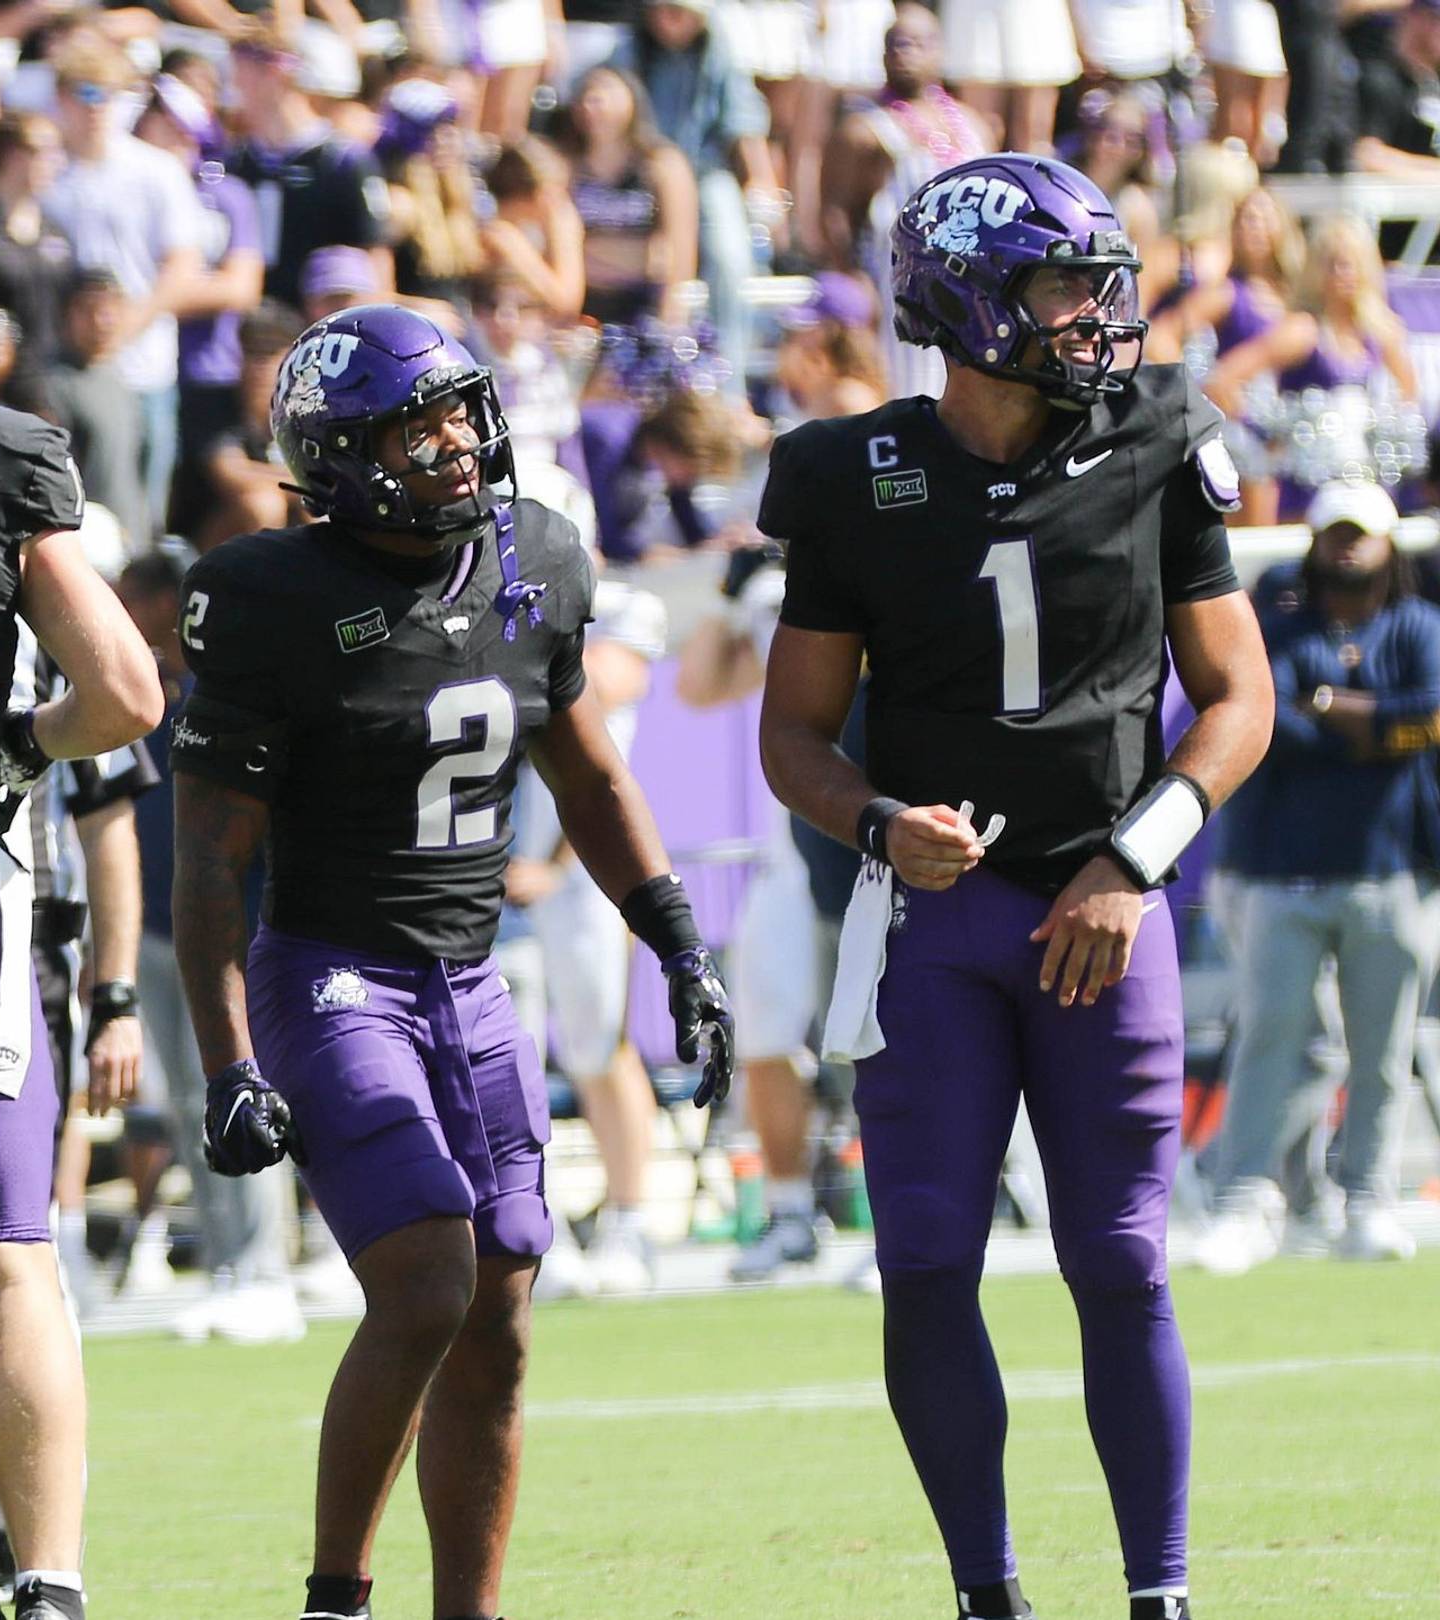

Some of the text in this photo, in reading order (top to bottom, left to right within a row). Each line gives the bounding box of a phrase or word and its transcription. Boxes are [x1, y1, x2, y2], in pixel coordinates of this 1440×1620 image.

[917, 176, 1029, 230] TCU
[868, 435, 899, 469] C
[987, 482, 1017, 500] TCU
[182, 590, 210, 651] 2
[976, 539, 1042, 713] 1
[415, 678, 516, 849] 2
